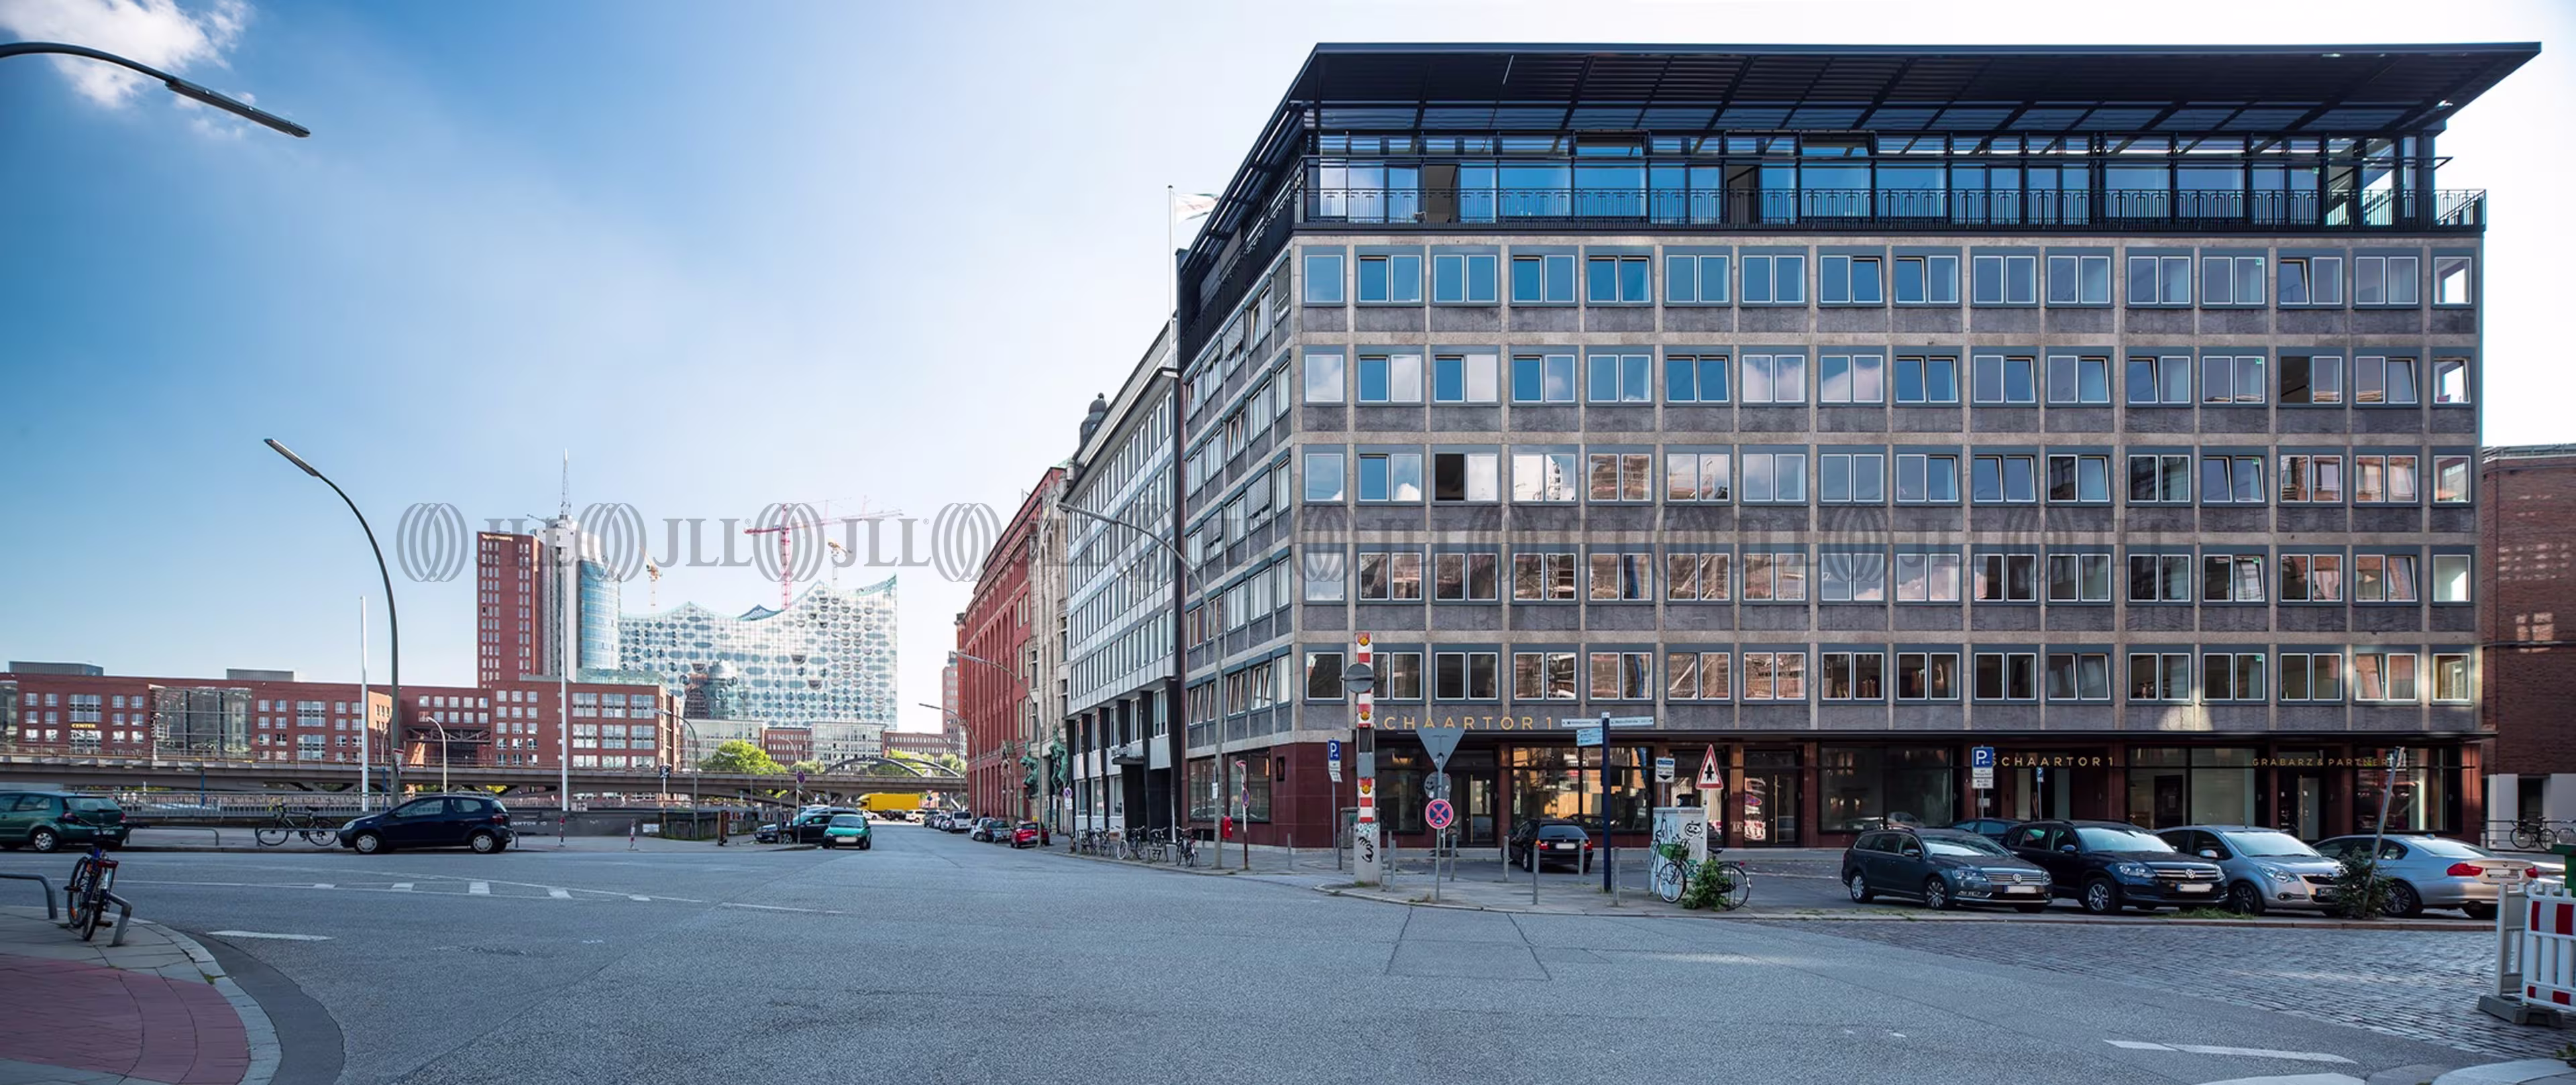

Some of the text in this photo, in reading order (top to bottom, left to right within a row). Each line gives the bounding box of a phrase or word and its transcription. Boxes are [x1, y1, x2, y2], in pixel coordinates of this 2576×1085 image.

[1374, 716, 1552, 730] CHAARTOR 1
[1976, 750, 1987, 765] P
[2108, 756, 2113, 766] 1
[2252, 758, 2313, 766] GRABARZ
[2317, 758, 2324, 766] &
